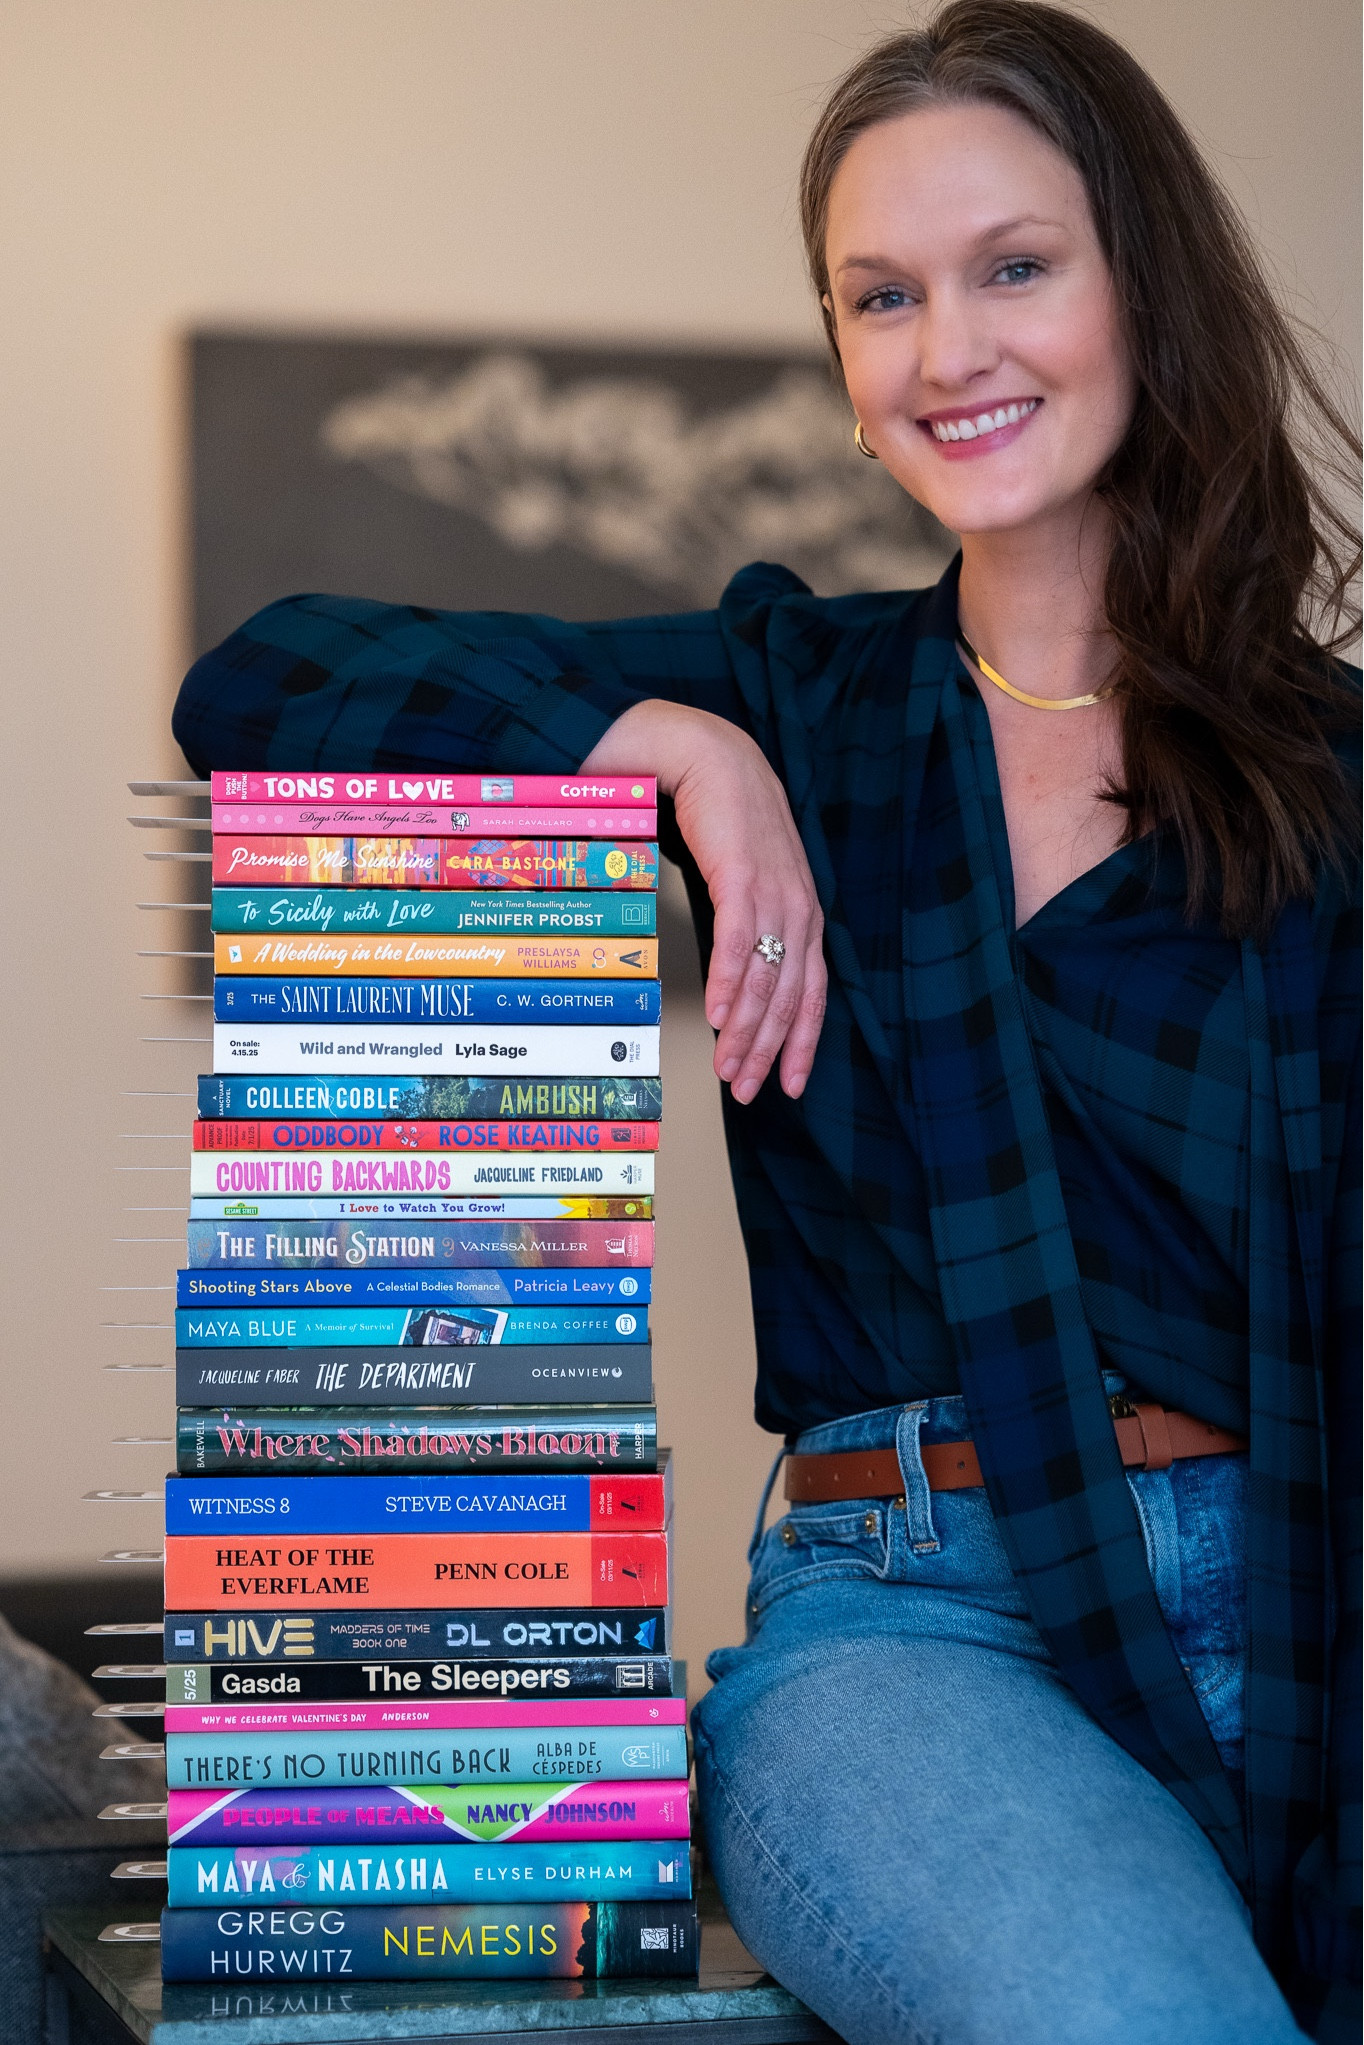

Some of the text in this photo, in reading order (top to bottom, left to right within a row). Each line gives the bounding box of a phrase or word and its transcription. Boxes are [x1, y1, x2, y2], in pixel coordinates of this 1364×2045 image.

[264, 778, 335, 798] TONS
[346, 779, 378, 798] OF
[560, 784, 616, 798] Cotter
[299, 812, 437, 830] Dogs Have Angels Too
[226, 845, 435, 874] Promise Me Sunshine
[450, 856, 576, 871] CARA BASTONE
[268, 894, 336, 931] Sicily
[344, 902, 381, 922] with
[387, 900, 435, 927] Love
[470, 900, 486, 908] New
[488, 900, 504, 908] York
[526, 901, 565, 910] Bestselling
[458, 914, 604, 928] JENNIFER PROBST
[254, 942, 506, 969] A Wedding in the Lowcountry
[518, 948, 580, 957] PRESLAYSA
[523, 960, 577, 968] WILLIAMS
[226, 992, 234, 1006] 3/25
[251, 984, 474, 1016] THE SAINT LAURENT MUSE
[497, 994, 614, 1007] C. W. GORTNER
[300, 1042, 443, 1058] Wild and Wrangled
[456, 1044, 528, 1059] Lyla Sage
[246, 1087, 399, 1109] COLLEEN COBLE
[500, 1085, 597, 1115] AMBUSH
[273, 1125, 384, 1146] ODDBODY
[439, 1125, 599, 1146] ROSE KEATING
[216, 1160, 450, 1192] COUNTING BACKWARDS
[474, 1167, 602, 1183] JACQUELINE FRIEDLAND
[340, 1203, 505, 1213] I Love to Watch You Grow!
[189, 1279, 352, 1297] Shooting Stars Above
[367, 1282, 500, 1291] A Celestial Bodies Romance
[514, 1279, 614, 1294] Patricia Leavy
[188, 1321, 296, 1337] MAYA BLUE
[349, 1323, 358, 1332] of
[360, 1323, 394, 1331] Survival
[511, 1321, 608, 1330] BRENDA COFFEE
[199, 1369, 300, 1384] JACQUELINE FABER
[316, 1362, 476, 1392] THE DEPARTMENT
[532, 1368, 610, 1378] OCEANVIEW
[197, 1420, 205, 1468] BAKEWELL
[218, 1425, 621, 1460] Where Shadows Bloom
[189, 1498, 290, 1514] WITNESS 8
[386, 1495, 567, 1513] STEVE CAVANAGH
[216, 1548, 374, 1567] HEAT OF THE
[434, 1563, 569, 1580] PENN COLE
[221, 1578, 369, 1594] EVERFLAME
[204, 1618, 315, 1656] HIVE
[330, 1624, 430, 1634] MADDERS OF TIME
[447, 1622, 622, 1646] DL ORTON
[184, 1669, 196, 1700] 5/25
[222, 1673, 300, 1694] Gasda
[362, 1664, 570, 1695] The Sleepers
[201, 1713, 367, 1724] WHY WE CELEBRATE VALENTINE'S DAY
[382, 1712, 430, 1721] ANDERSON
[537, 1742, 597, 1758] ALBA DE
[184, 1748, 511, 1782] THERE'S NO TURNING BACK
[532, 1758, 602, 1775] CÉSPEDES
[223, 1804, 444, 1827] PEOPLE OF MEANS
[467, 1803, 532, 1824] NANCY
[545, 1801, 636, 1824] JOHNSON
[198, 1858, 448, 1893] MAYA & NATASHA
[474, 1866, 632, 1881] ELYSE DURHAM
[218, 1910, 345, 1936] GREGG
[384, 1924, 557, 1956] NEMESIS
[211, 1950, 352, 1974] HURWITZ
